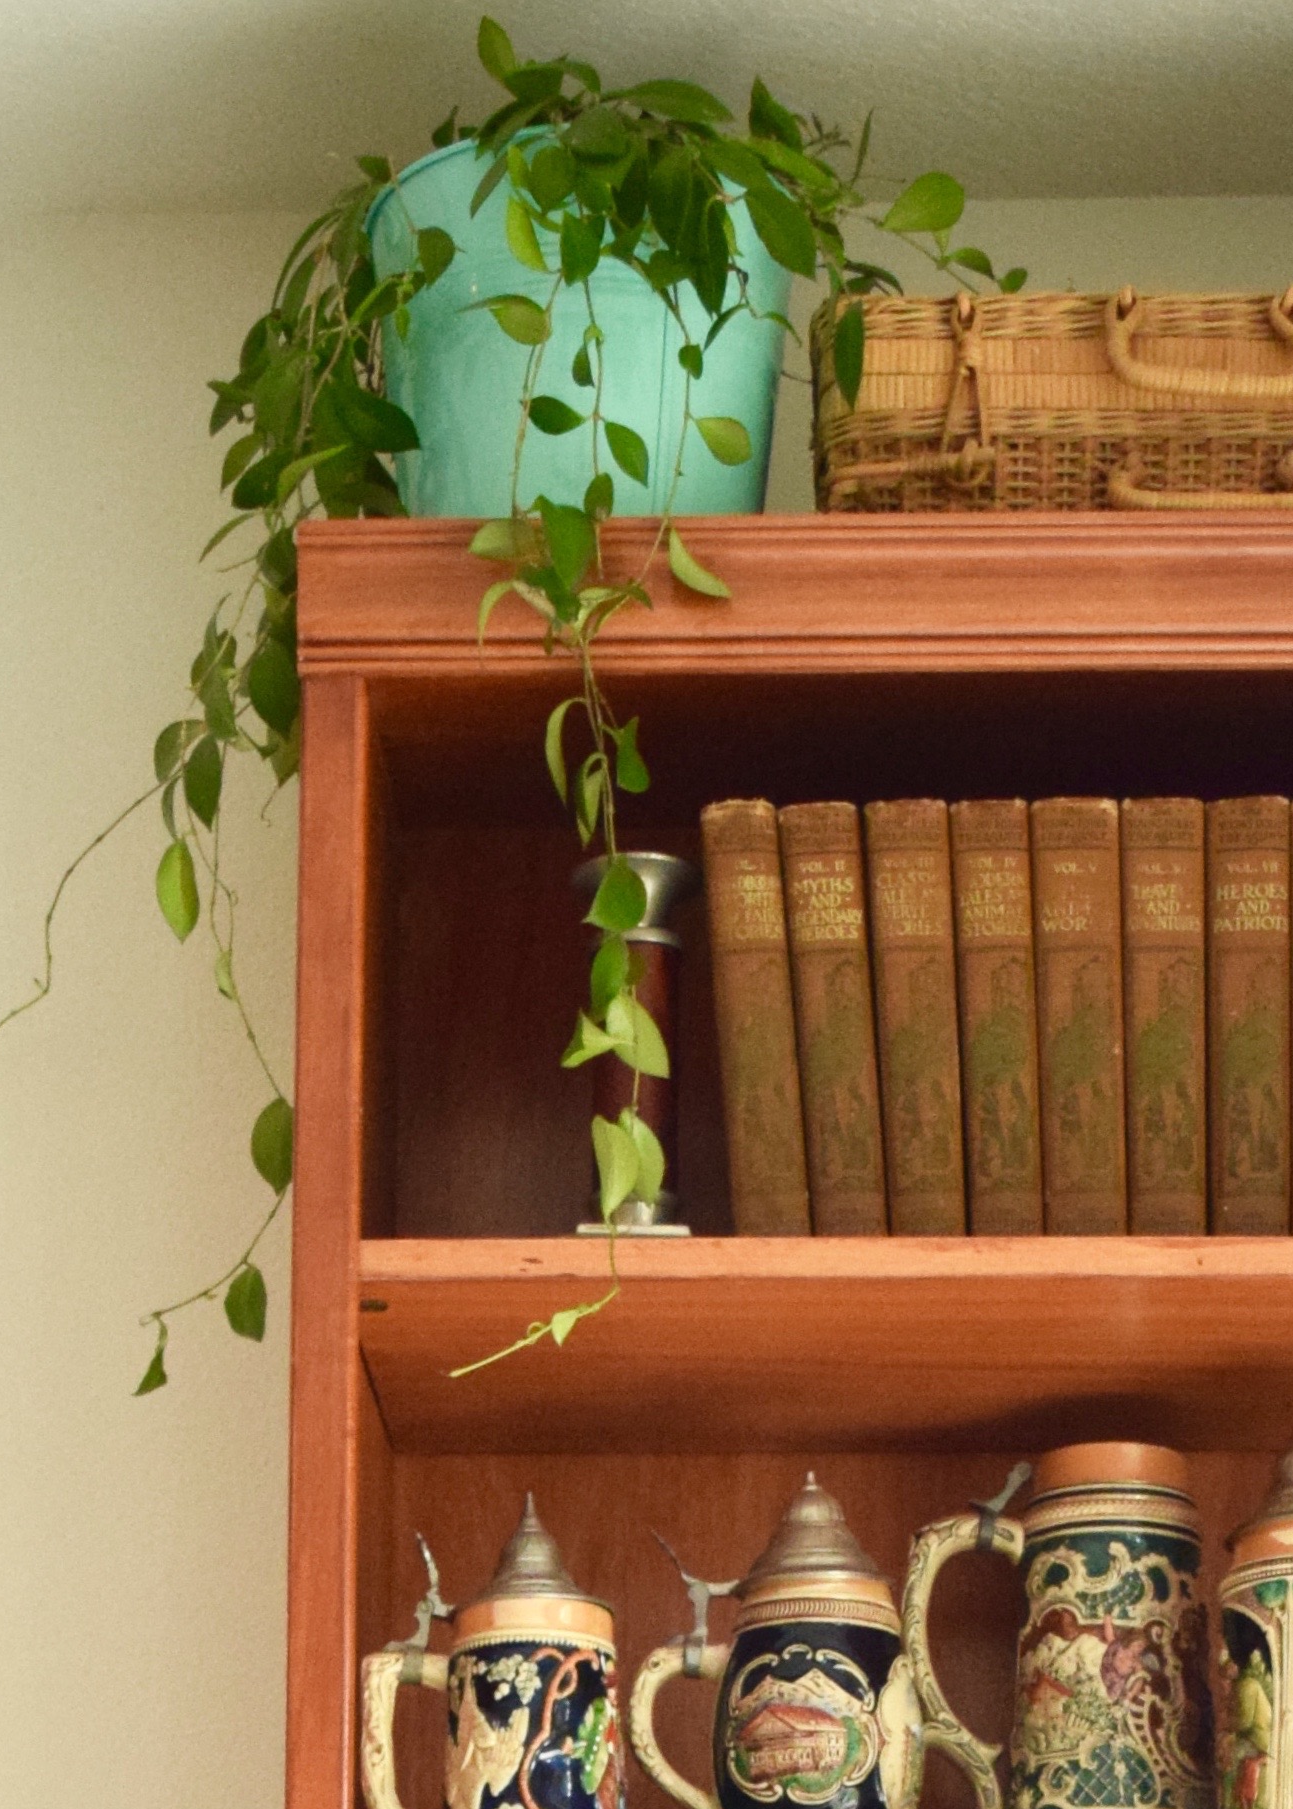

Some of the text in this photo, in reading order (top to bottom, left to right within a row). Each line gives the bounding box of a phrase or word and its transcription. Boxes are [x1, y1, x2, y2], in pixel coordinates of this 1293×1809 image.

[793, 878, 855, 893] MYTHS
[1215, 884, 1288, 900] HEROES
[809, 894, 842, 909] AND
[1145, 900, 1180, 915] AND
[1235, 899, 1271, 915] AND
